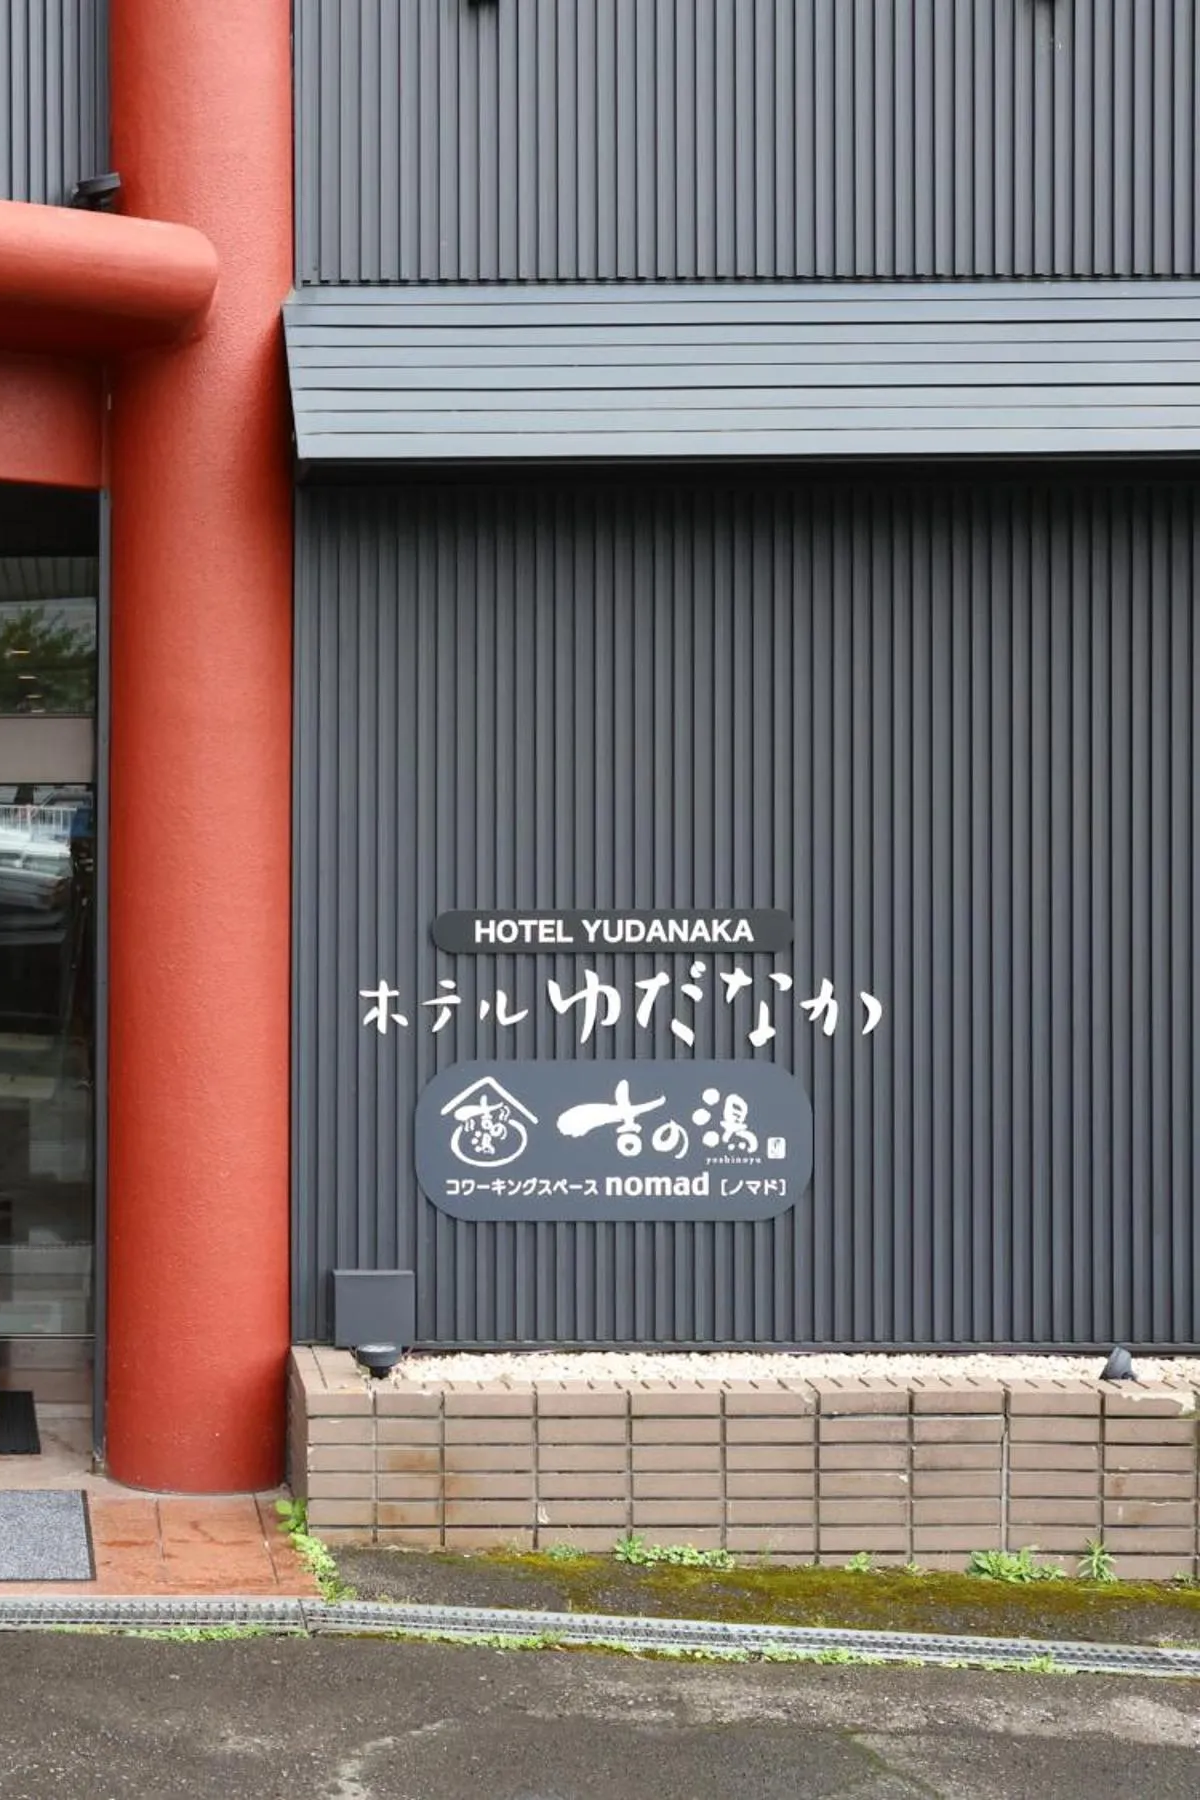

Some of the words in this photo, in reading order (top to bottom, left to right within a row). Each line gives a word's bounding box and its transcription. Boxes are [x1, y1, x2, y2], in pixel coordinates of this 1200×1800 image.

[474, 919, 574, 944] HOTEL
[581, 919, 755, 944] YUDANAKA
[556, 1079, 759, 1159] 吉の湯
[445, 1176, 599, 1197] コワーキングスペース
[605, 1171, 710, 1197] nomad
